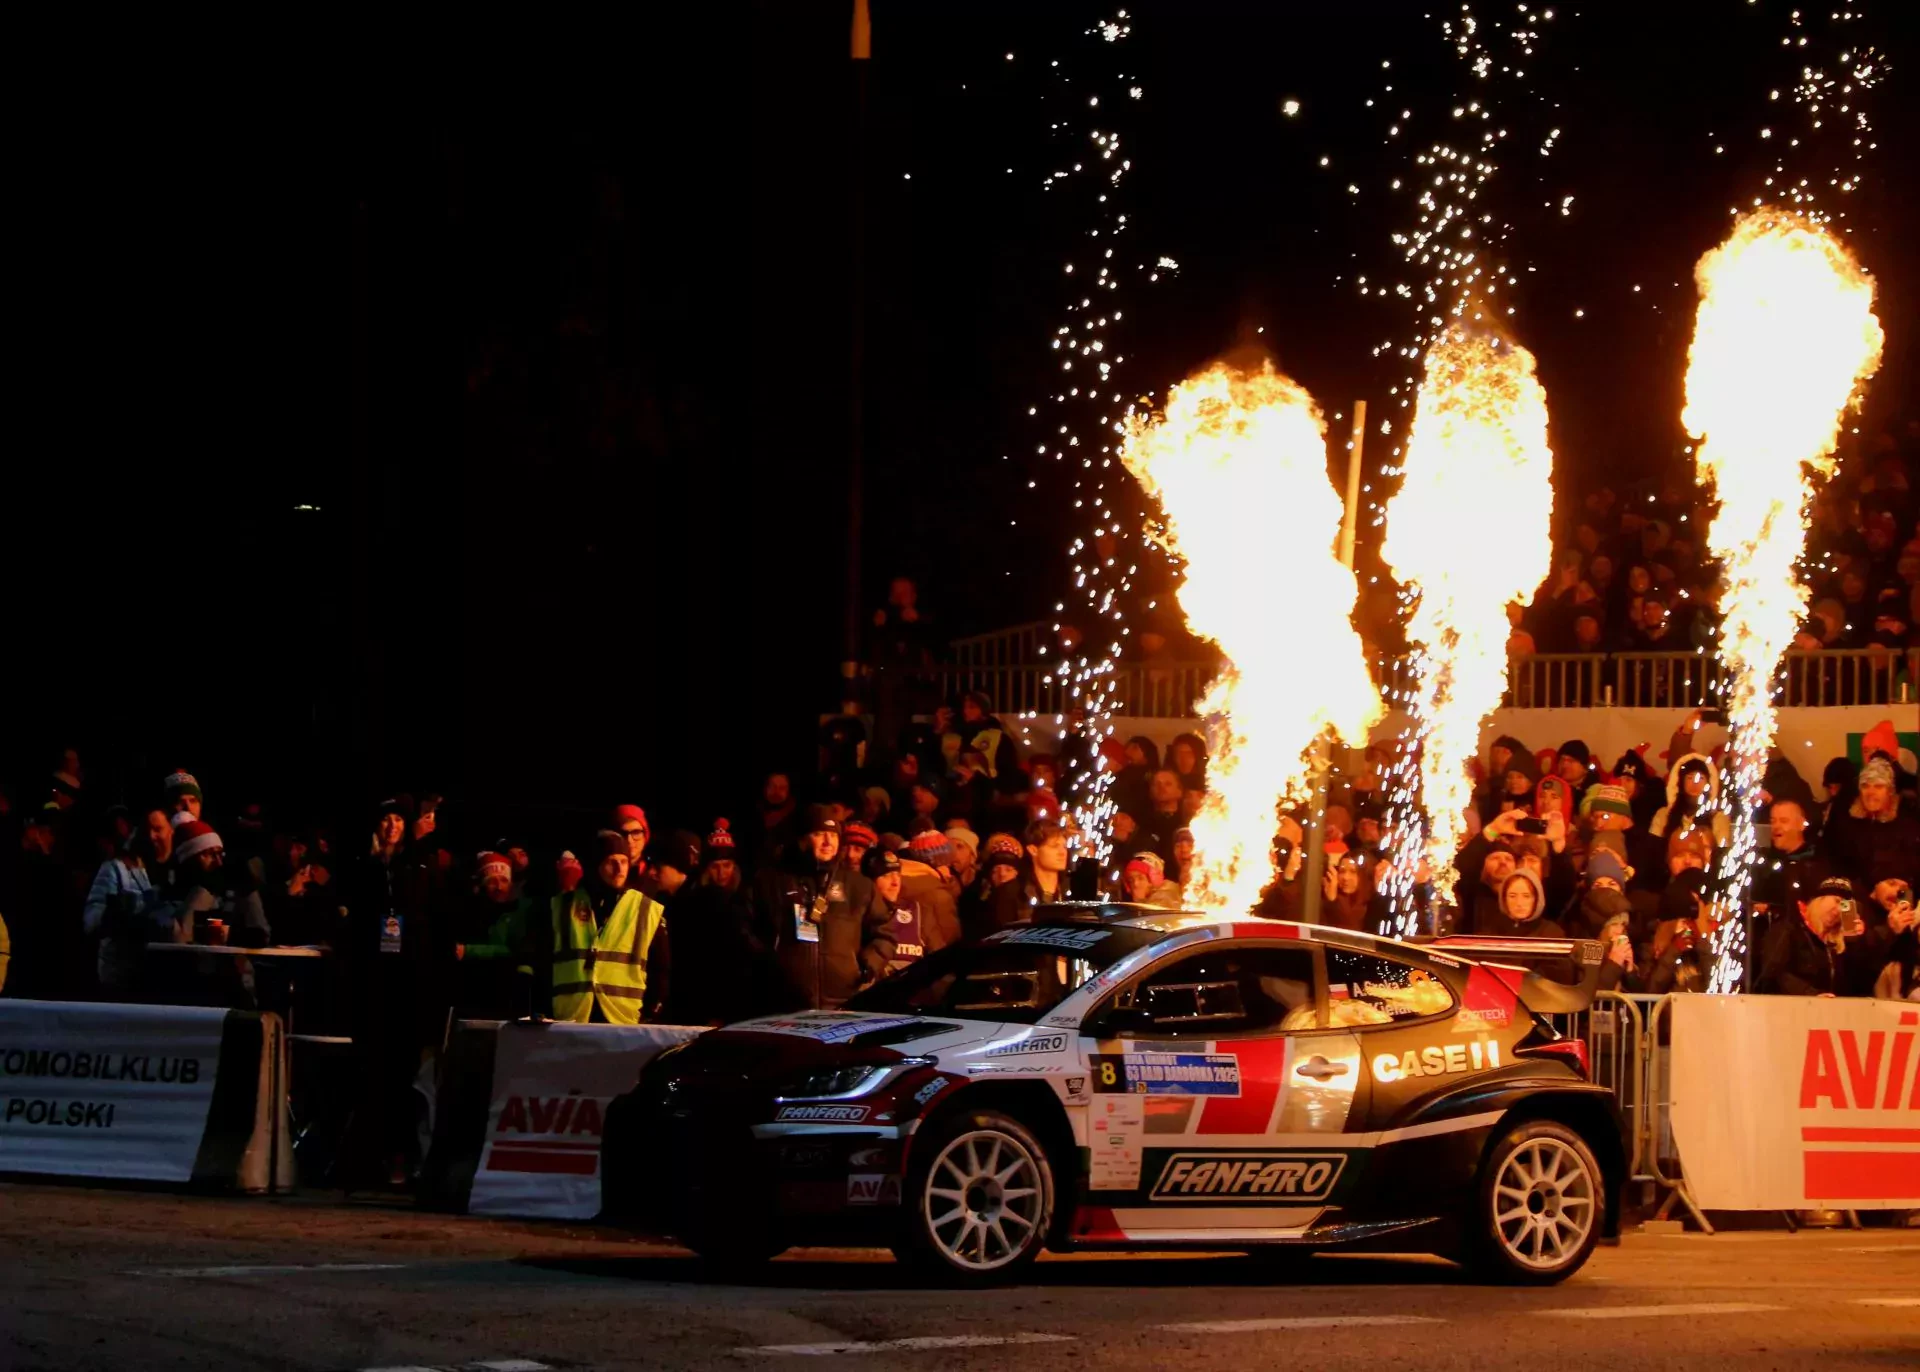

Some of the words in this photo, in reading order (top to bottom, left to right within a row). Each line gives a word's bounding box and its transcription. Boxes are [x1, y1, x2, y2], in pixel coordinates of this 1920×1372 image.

[0, 1049, 199, 1083] OMOBILKLUB
[1101, 1062, 1117, 1085] 8
[1214, 1066, 1238, 1082] 2025
[1373, 1044, 1468, 1083] CASE
[1799, 1010, 1920, 1110] AVI
[6, 1099, 115, 1127] POLSKI
[781, 1107, 864, 1120] FANFARO
[1161, 1161, 1332, 1193] FANFARO
